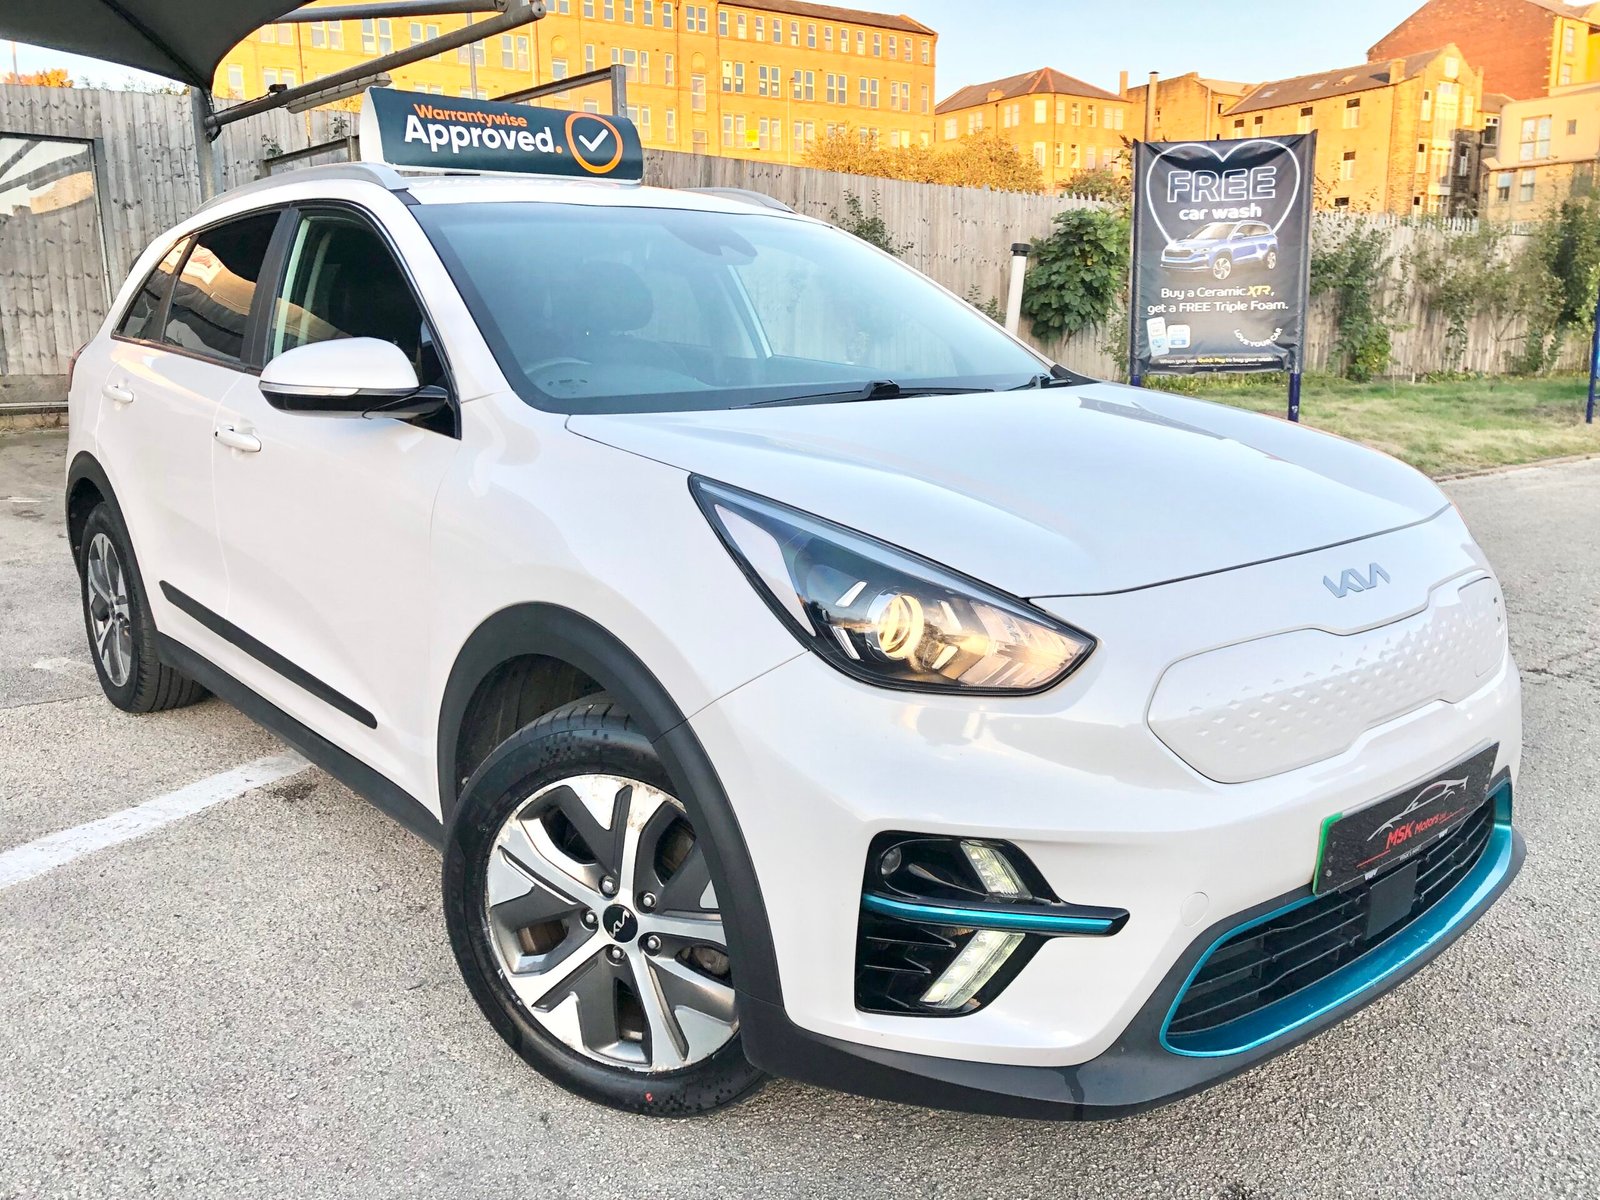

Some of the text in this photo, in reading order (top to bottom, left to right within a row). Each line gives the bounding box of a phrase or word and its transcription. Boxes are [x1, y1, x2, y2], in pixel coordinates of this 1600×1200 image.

[413, 104, 528, 128] Warrantywise
[404, 115, 563, 154] Approved.
[1167, 166, 1276, 203] FREE
[1178, 203, 1262, 220] car wash
[1161, 288, 1184, 300] Buy
[1187, 290, 1194, 298] a
[1197, 286, 1247, 297] Ceramic
[1147, 300, 1289, 316] get a FREE Triple Foam.
[1234, 327, 1283, 347] LOVE YOUR CAR
[1323, 562, 1391, 598] KIA
[1386, 820, 1415, 850] MSK
